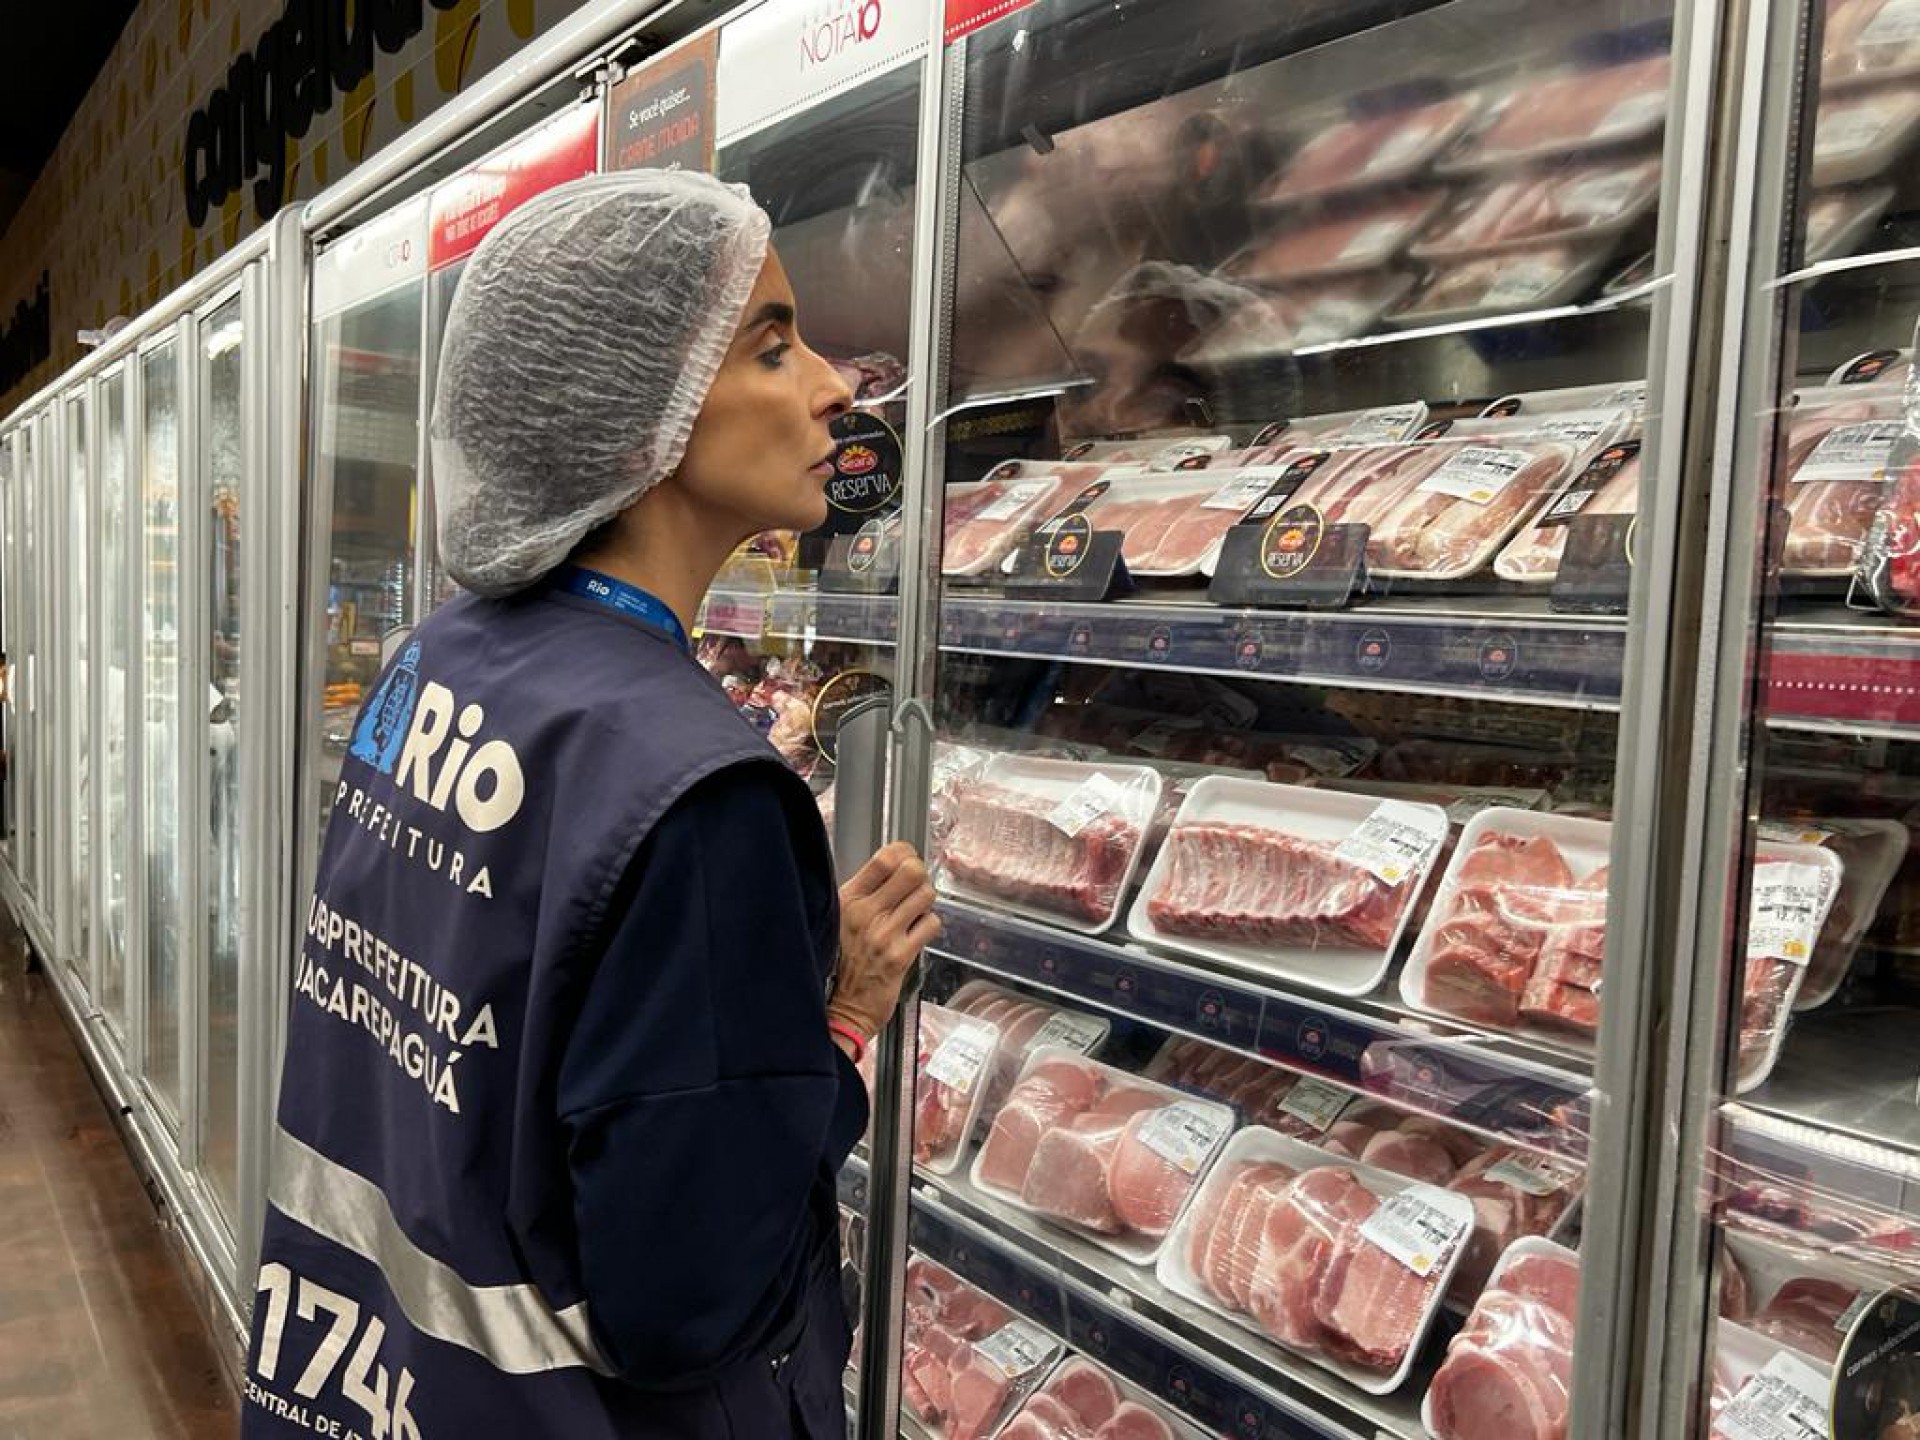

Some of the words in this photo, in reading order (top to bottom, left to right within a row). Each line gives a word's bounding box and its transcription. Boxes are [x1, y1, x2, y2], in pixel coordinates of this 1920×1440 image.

[334, 780, 494, 899] PREFEITURA
[295, 951, 461, 1114] JACAREPAGUÁ
[315, 1413, 342, 1439] DE
